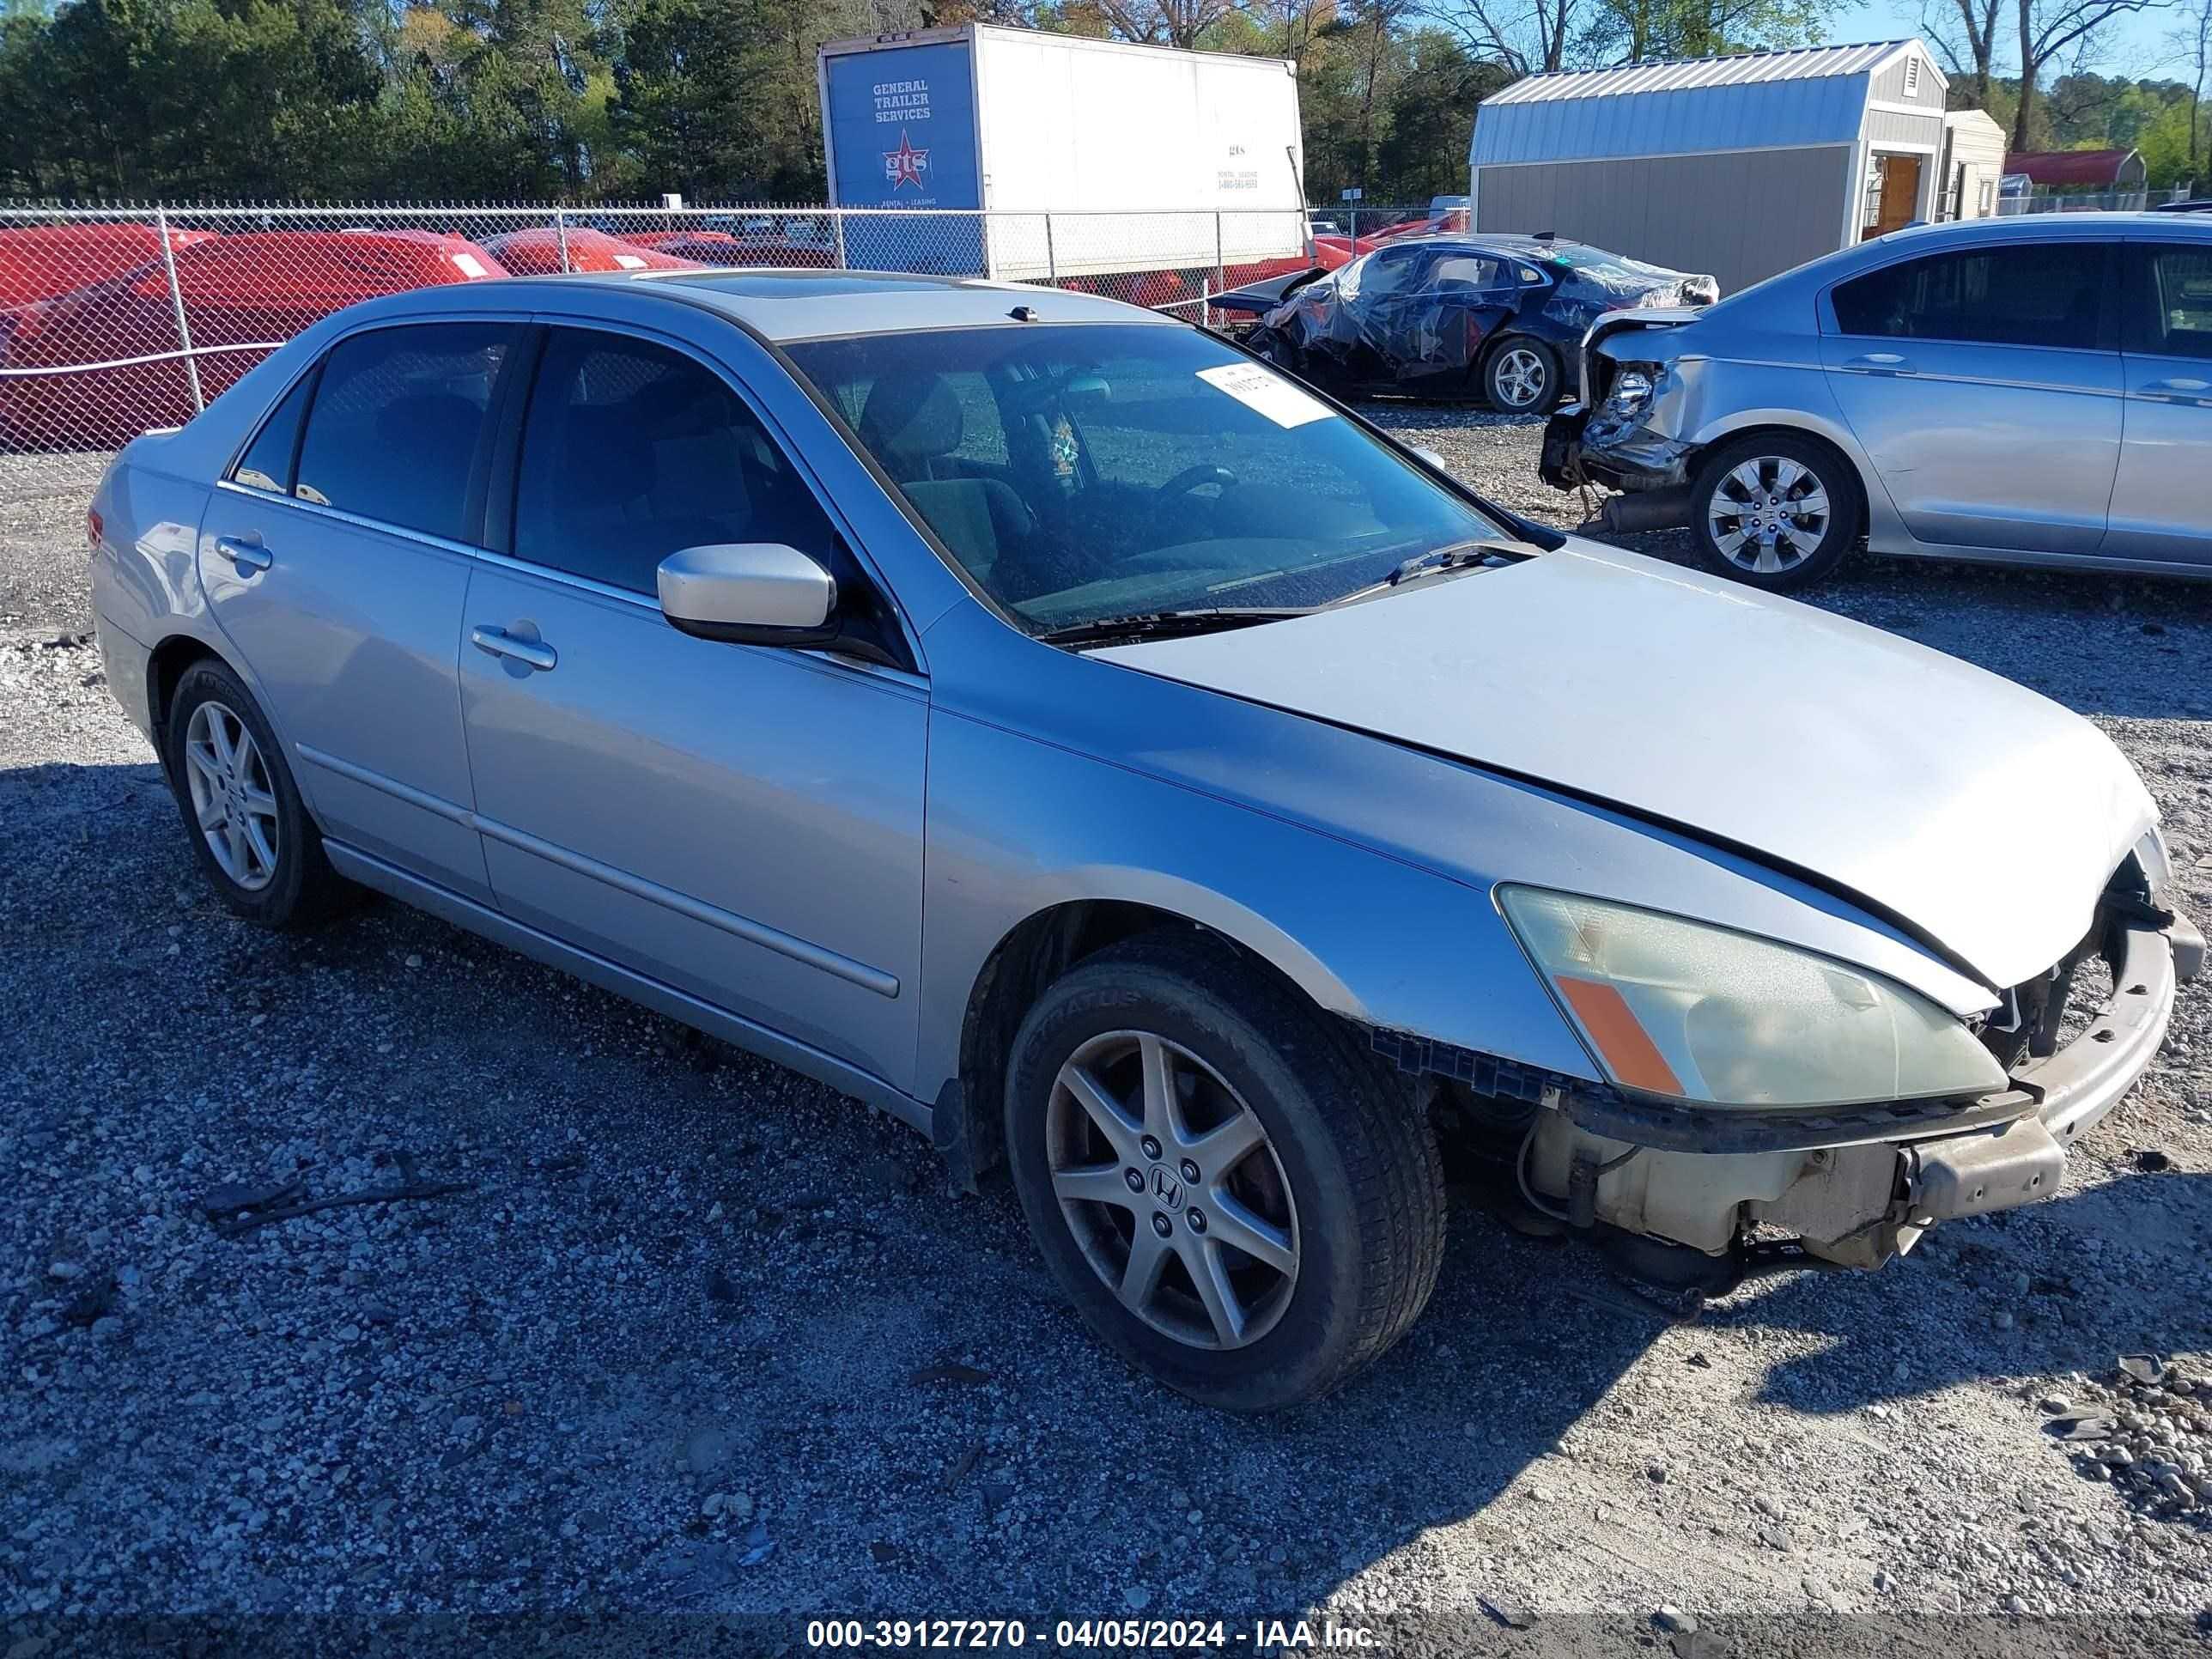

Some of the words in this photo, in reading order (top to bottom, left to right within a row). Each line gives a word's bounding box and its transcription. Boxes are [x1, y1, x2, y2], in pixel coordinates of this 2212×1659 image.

[873, 80, 927, 95] GENERAL
[874, 94, 929, 109] TRAILER
[875, 107, 931, 123] SERVICES
[886, 150, 927, 179] gts
